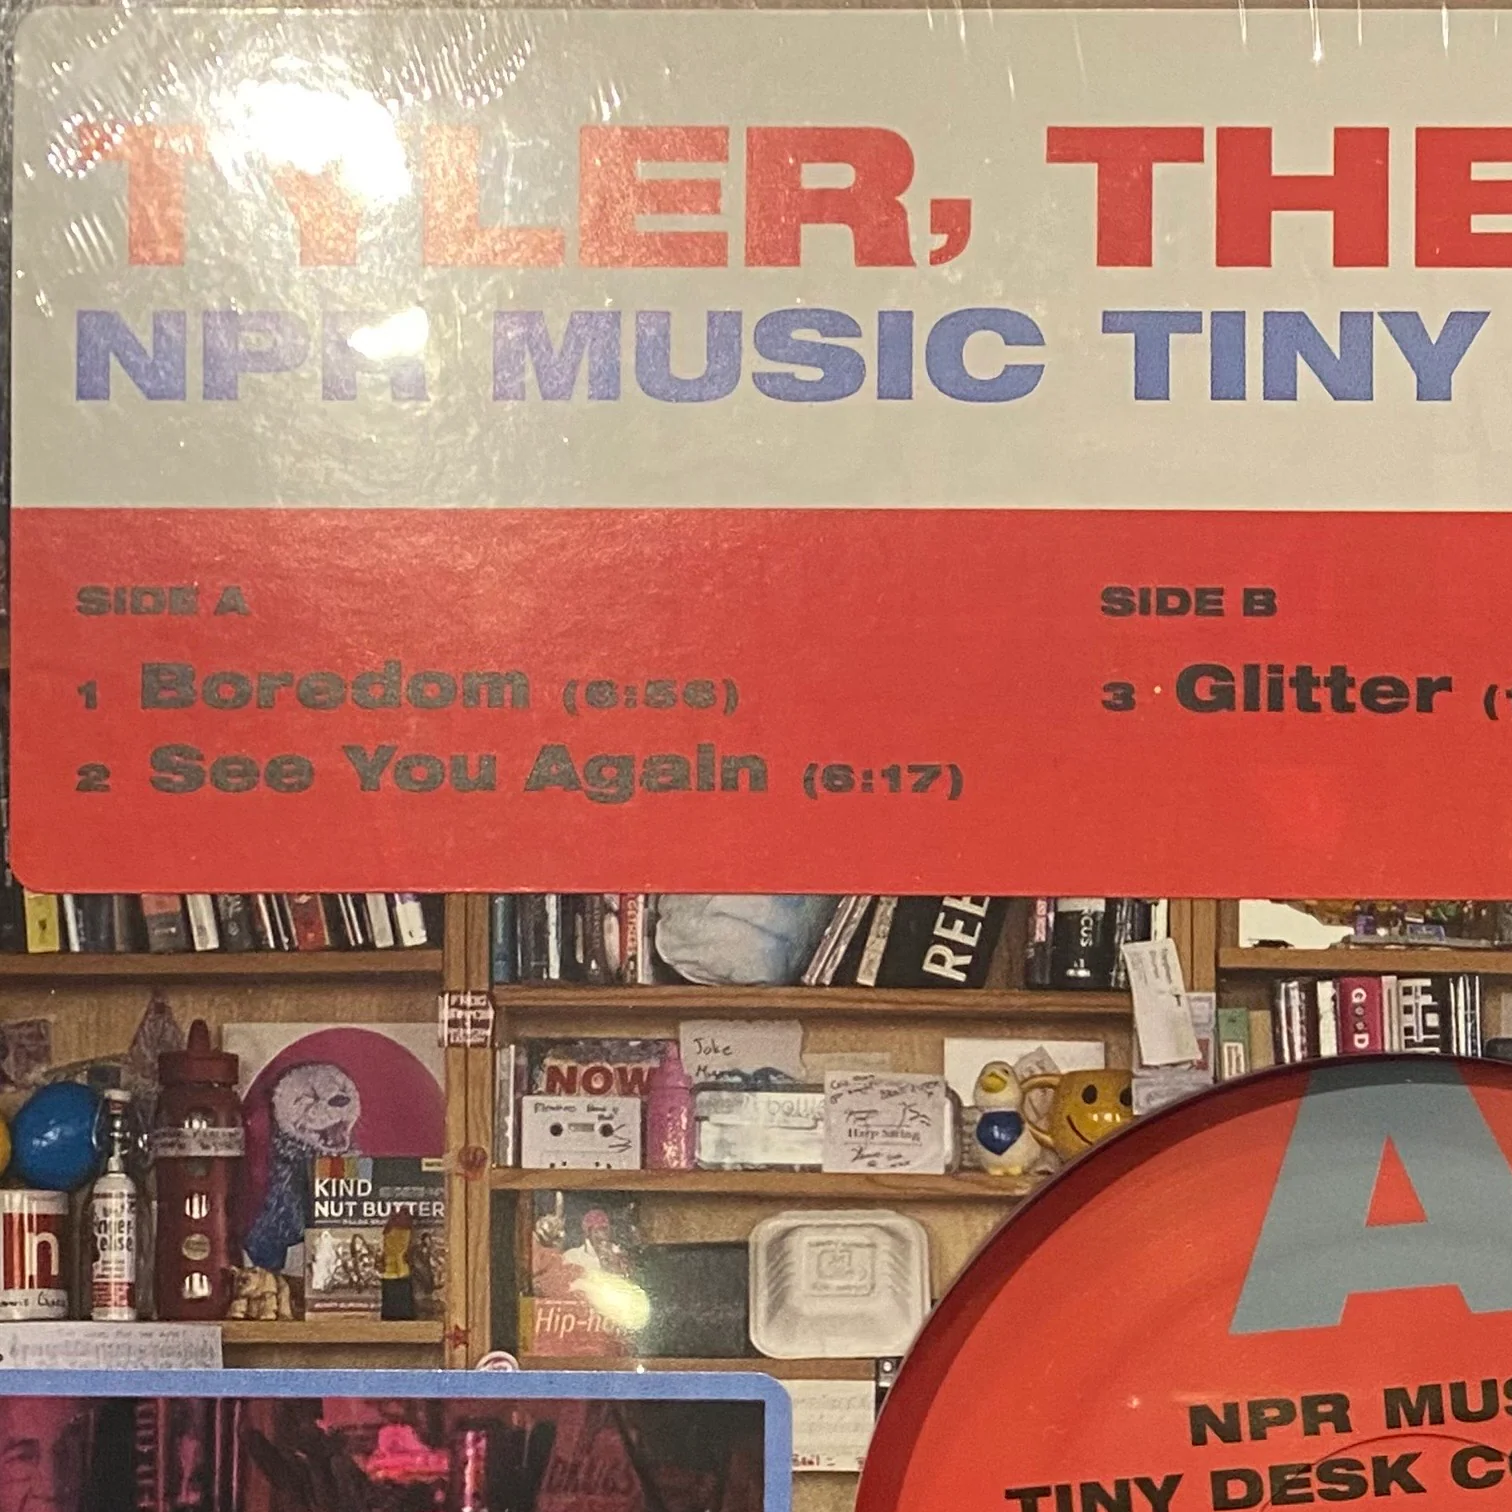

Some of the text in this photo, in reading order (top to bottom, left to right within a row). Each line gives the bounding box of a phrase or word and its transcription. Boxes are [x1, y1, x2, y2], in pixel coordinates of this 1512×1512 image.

[80, 125, 974, 270] TYLER,
[76, 309, 432, 402] NPR
[492, 309, 1044, 403] MUSIC
[1101, 310, 1490, 402] TINY
[76, 585, 252, 617] SIDE A
[1100, 586, 1278, 617] SIDE B
[76, 680, 98, 711] 1
[140, 660, 532, 712] Boredom
[1101, 683, 1137, 713] 3
[1174, 662, 1454, 715] Glitter
[75, 742, 965, 805] 2 See You Again (6:17)
[694, 1037, 733, 1056] Joke
[545, 1065, 660, 1096] NOW
[314, 1178, 373, 1198] KIND
[314, 1201, 446, 1217] NUT BUTTER
[1187, 1393, 1354, 1448] NPR
[1210, 1452, 1427, 1512] DESK
